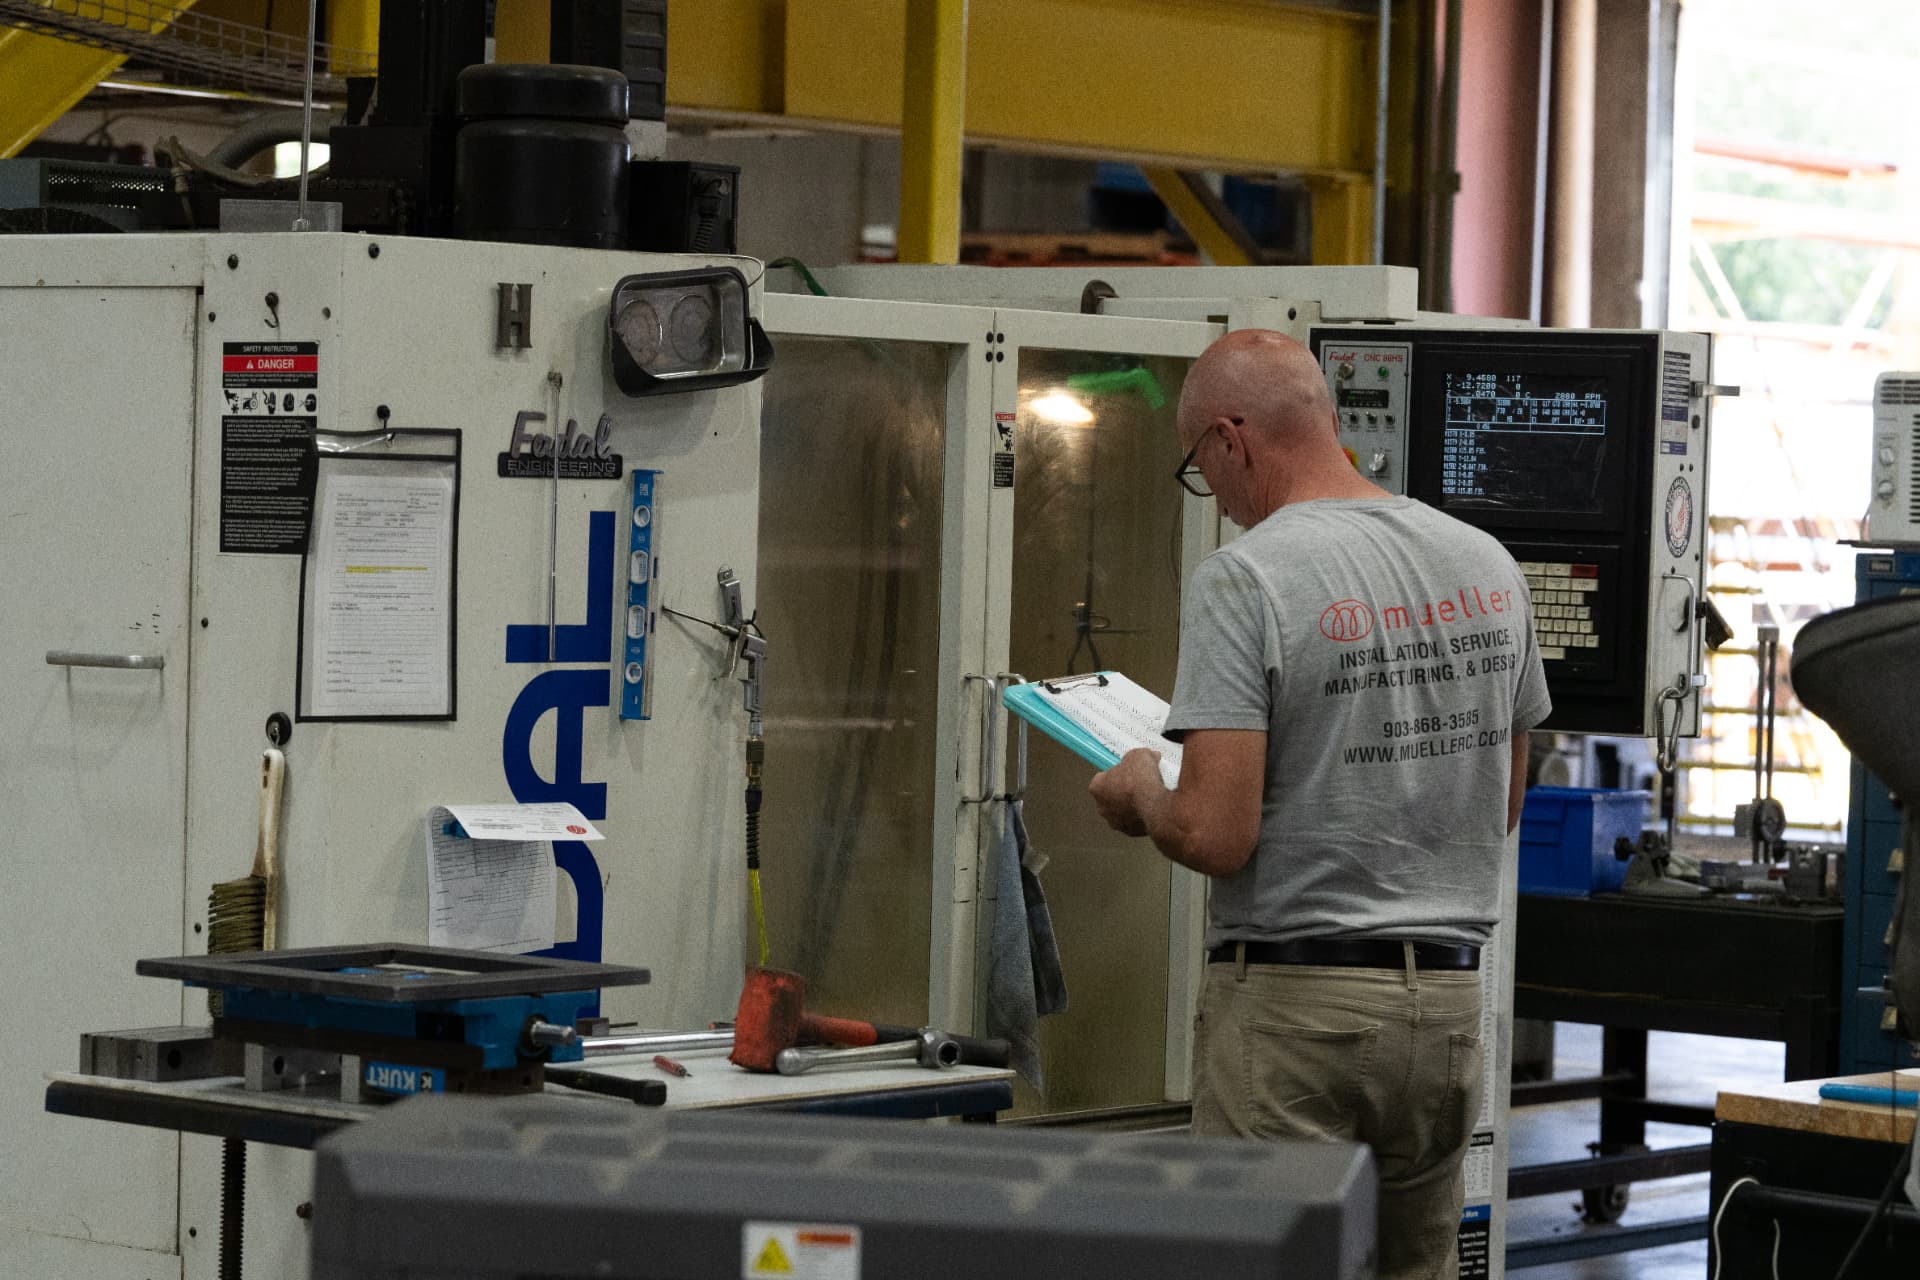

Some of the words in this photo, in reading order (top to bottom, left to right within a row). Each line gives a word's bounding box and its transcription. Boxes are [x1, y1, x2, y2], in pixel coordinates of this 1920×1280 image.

[496, 282, 533, 349] H
[257, 359, 295, 369] DANGER
[1363, 353, 1380, 362] CNC
[510, 410, 613, 460] Fadal
[507, 459, 616, 473] ENGINEERING
[1383, 586, 1511, 630] mueller
[1340, 641, 1445, 670] INSTALLATION,
[1450, 629, 1513, 655] SERVICE,
[1466, 660, 1477, 677] &
[1482, 653, 1516, 674] DESIG
[1383, 708, 1479, 738] 903-868-3585
[366, 1066, 416, 1091] KURT
